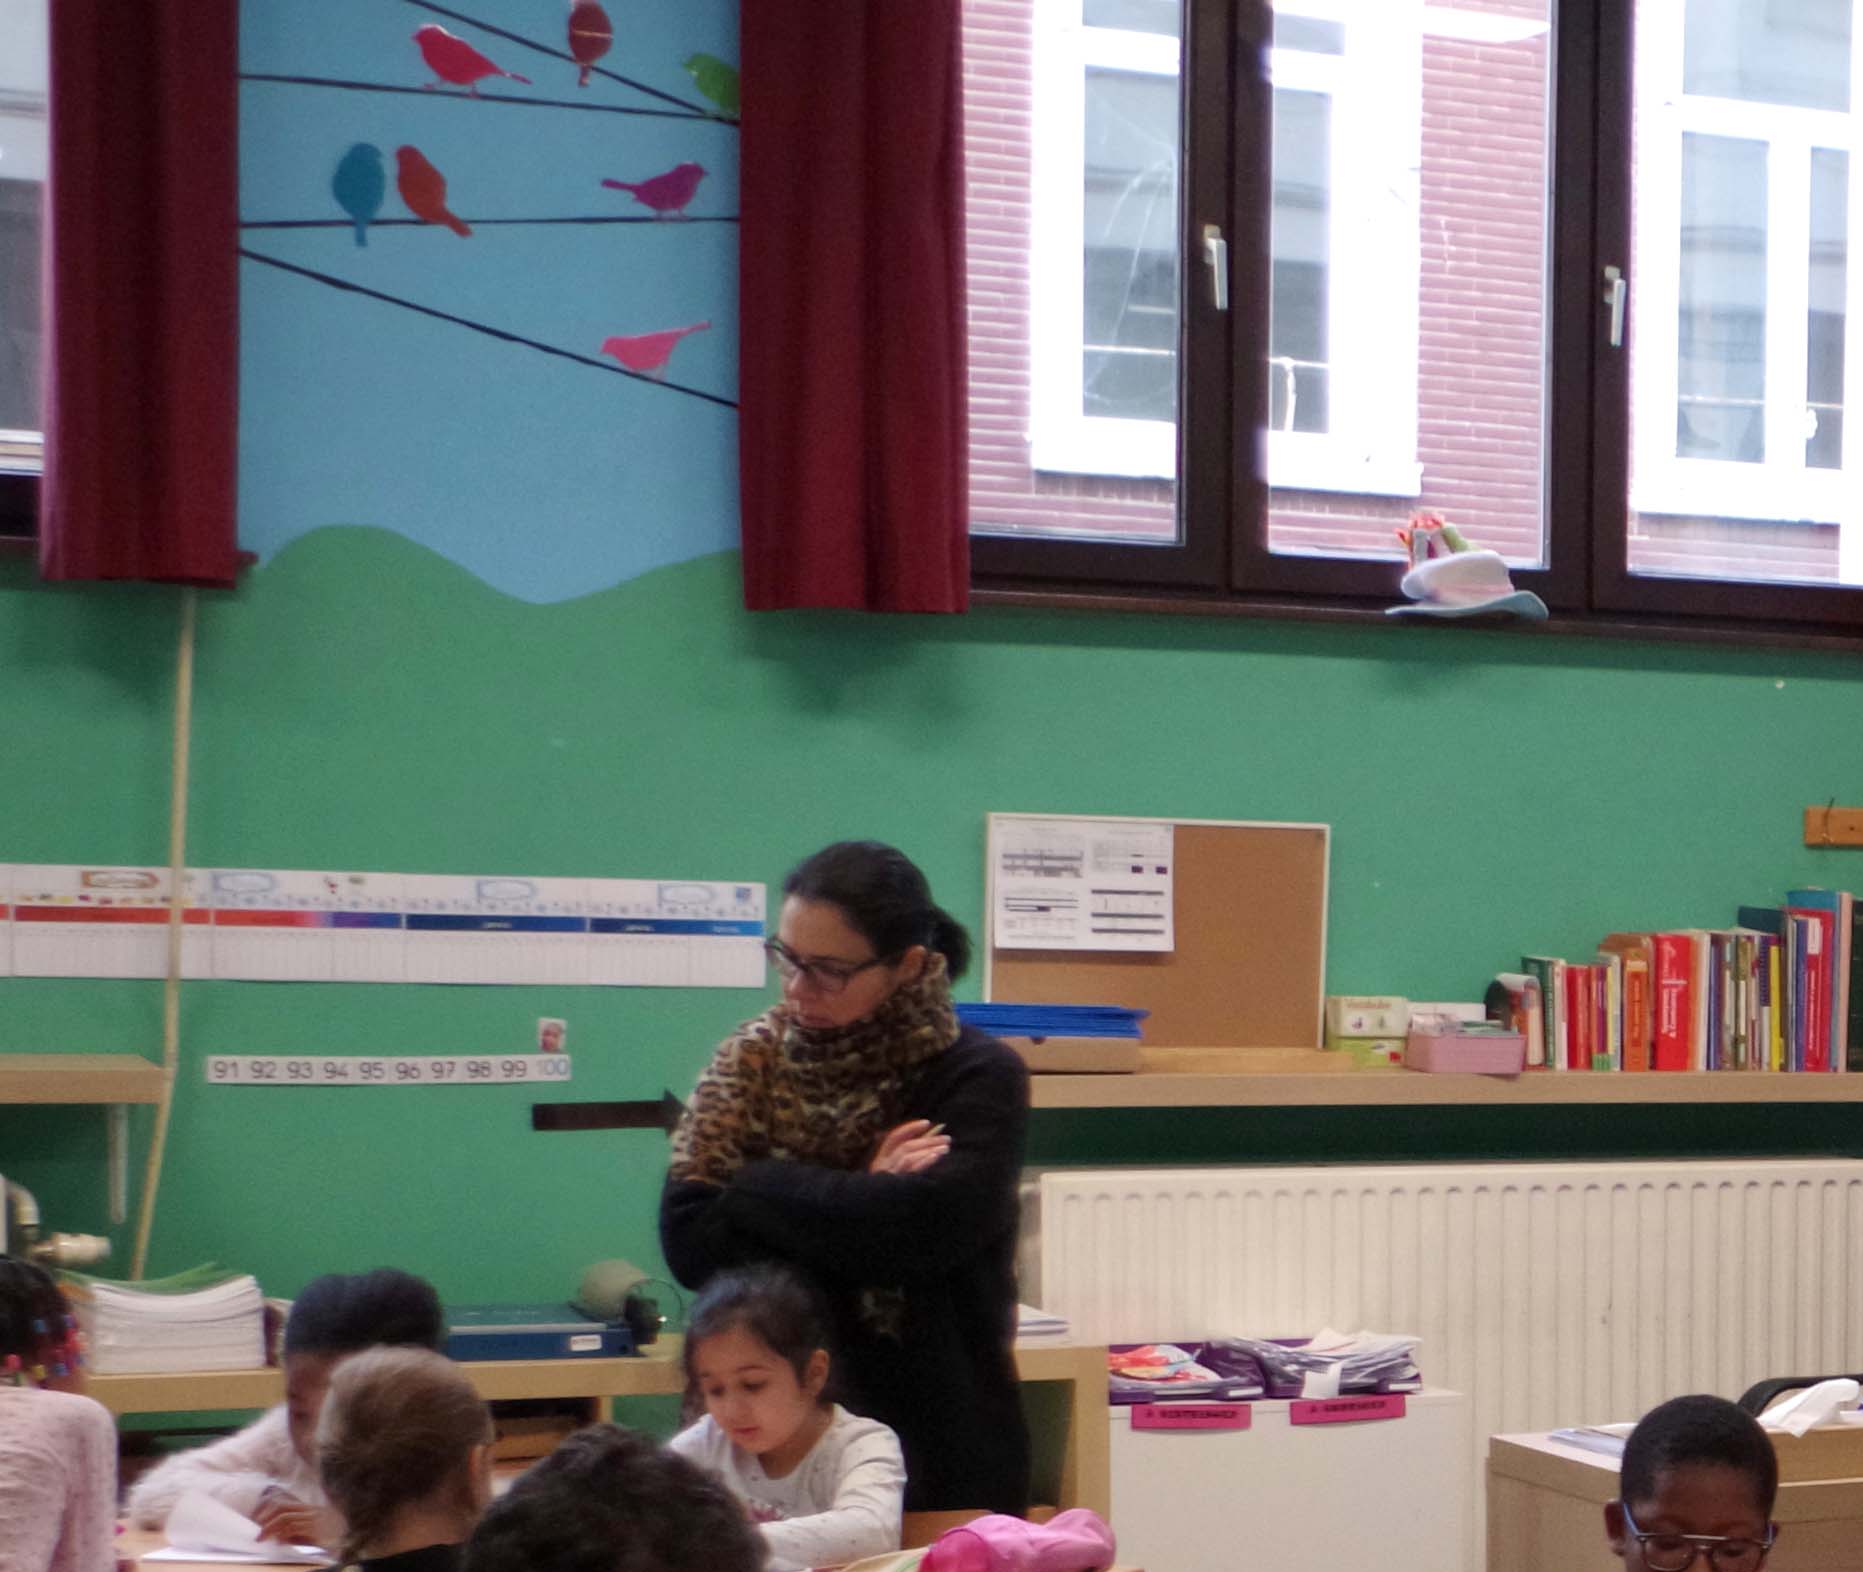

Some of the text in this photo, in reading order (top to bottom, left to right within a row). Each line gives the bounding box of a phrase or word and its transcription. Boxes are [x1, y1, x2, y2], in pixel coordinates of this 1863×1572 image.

[214, 1061, 239, 1079] 91
[251, 1061, 276, 1079] 92
[287, 1061, 313, 1079] 93
[323, 1061, 349, 1079] 94
[359, 1061, 385, 1079] 95
[395, 1061, 421, 1079] 96
[431, 1061, 456, 1078] 97
[466, 1061, 492, 1078] 98
[501, 1060, 528, 1078] 99
